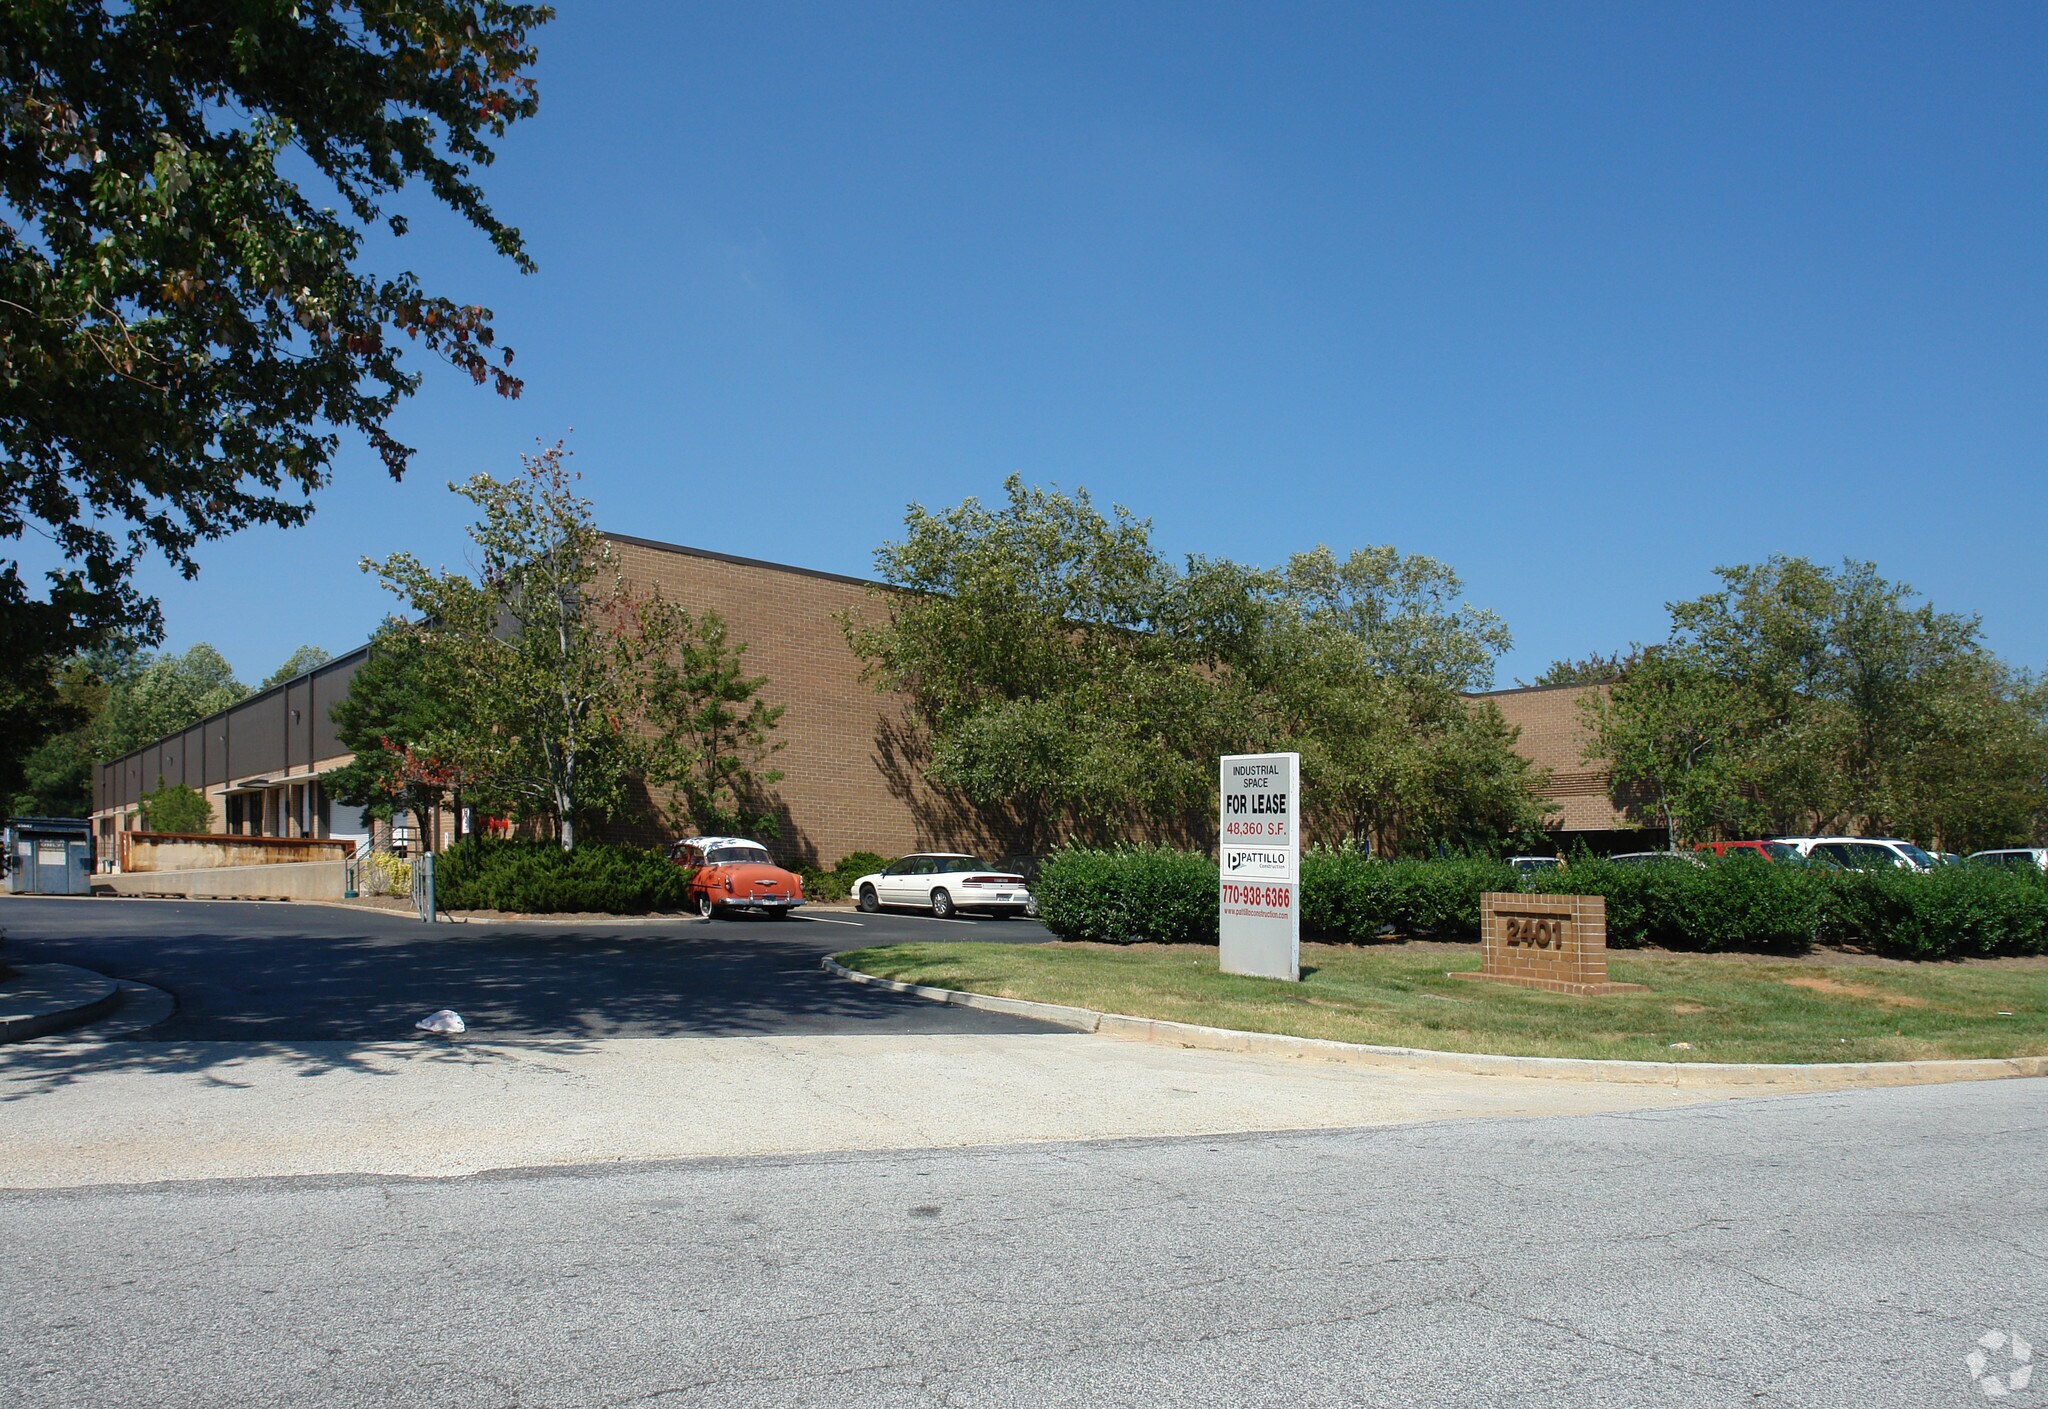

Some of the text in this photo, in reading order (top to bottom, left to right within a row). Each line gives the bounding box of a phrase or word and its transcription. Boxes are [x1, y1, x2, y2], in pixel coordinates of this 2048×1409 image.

[1233, 765, 1279, 776] INDUSTRIAL
[1243, 778, 1268, 788] SPACE
[1226, 794, 1286, 814] FOR LEASE
[1227, 822, 1287, 836] 48,360 S.F.
[1241, 852, 1285, 863] PATTILLO
[1222, 884, 1290, 908] 770-938-6366
[1225, 910, 1288, 918] www.pattilloconstruction.com
[1507, 918, 1561, 950] 2401
